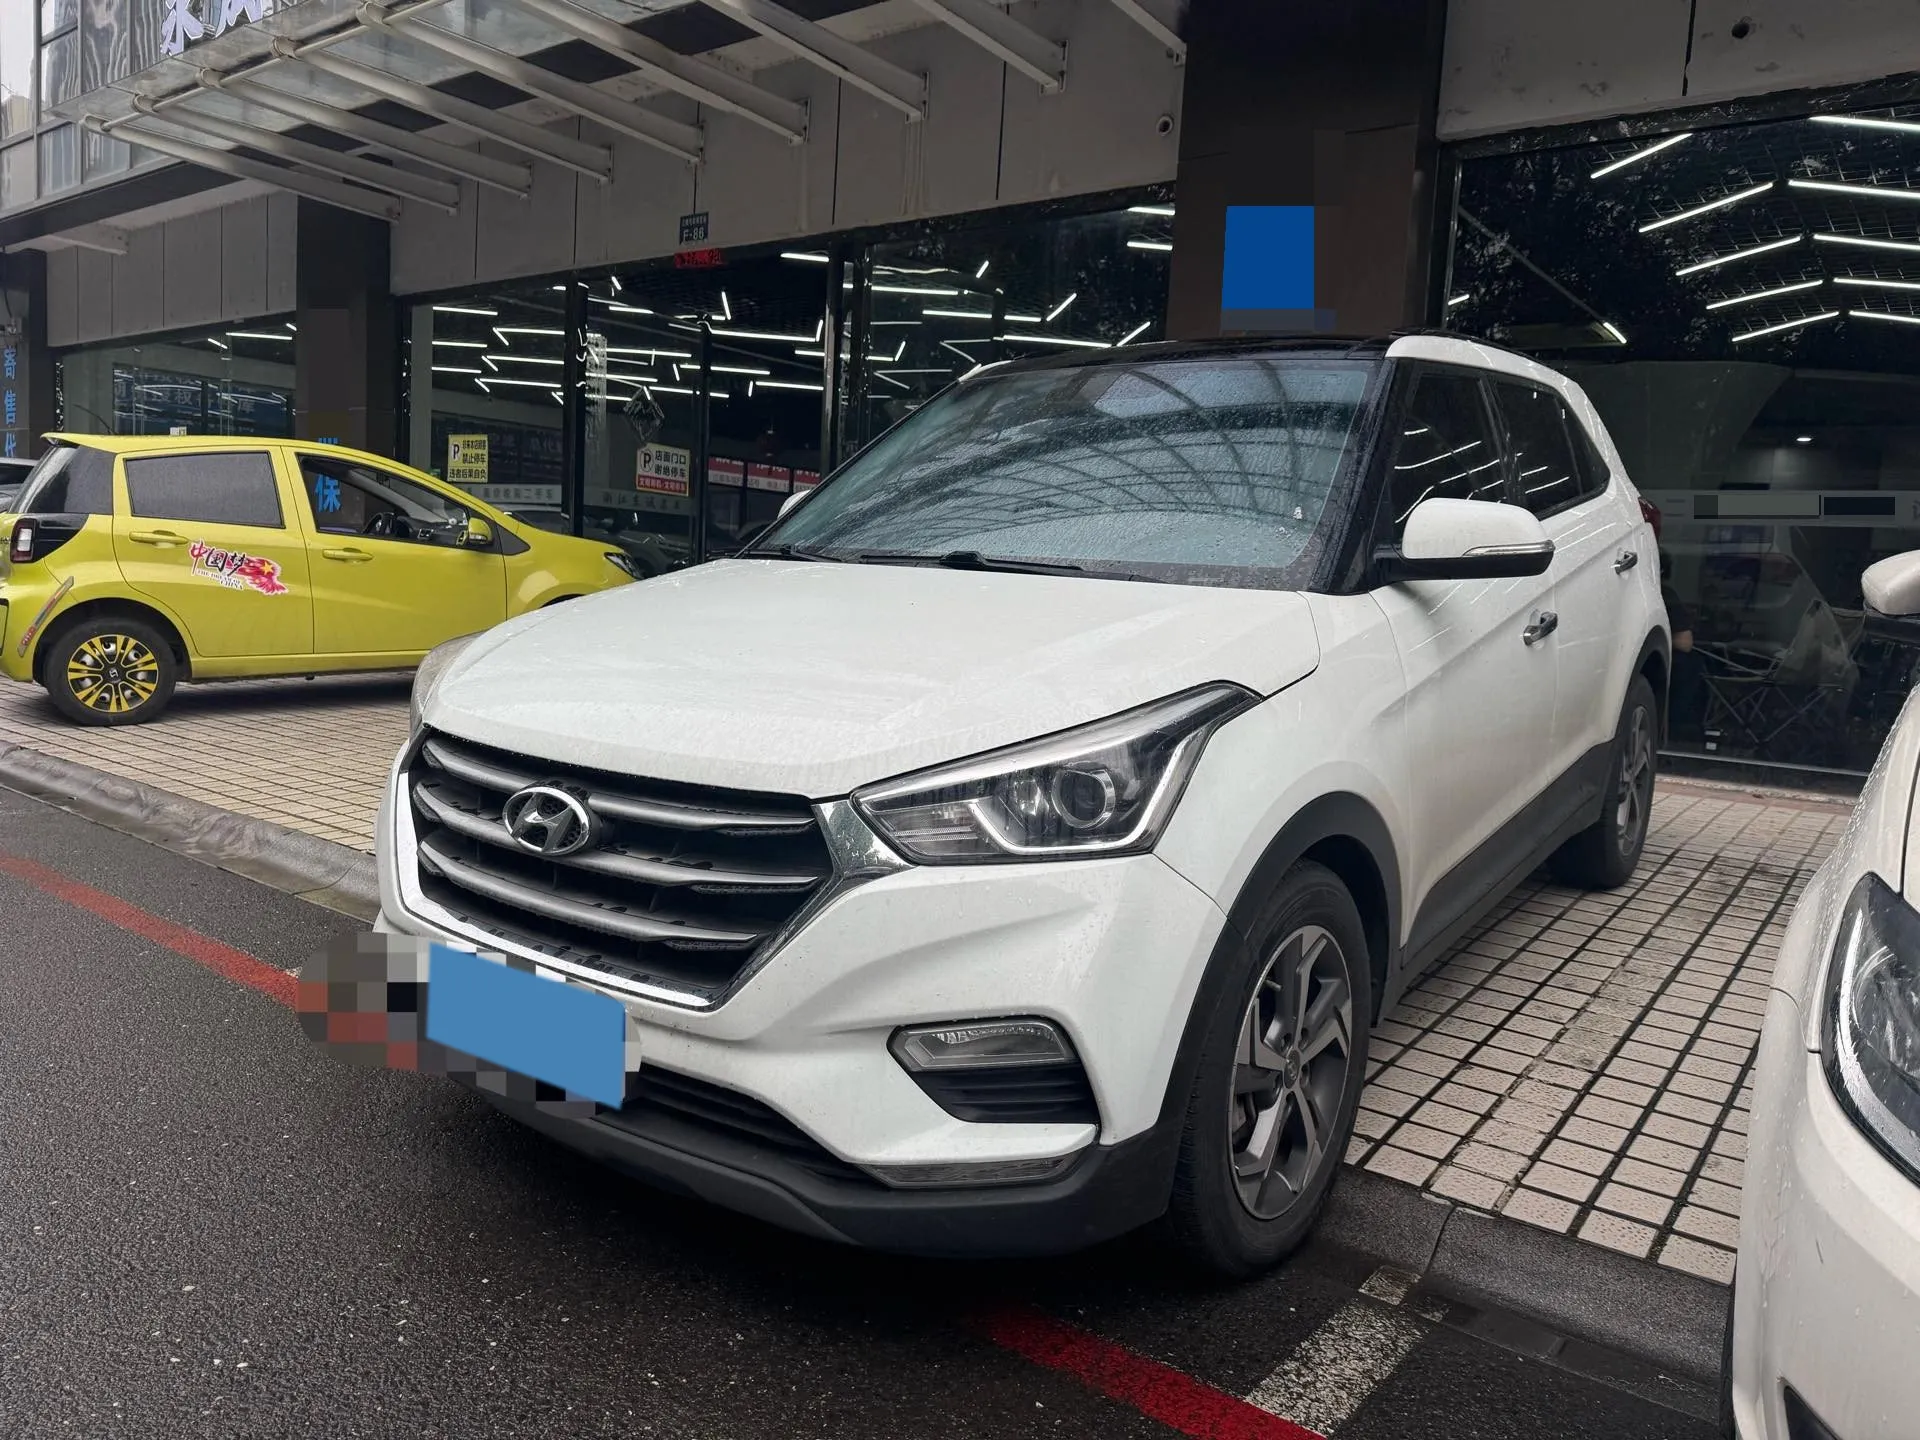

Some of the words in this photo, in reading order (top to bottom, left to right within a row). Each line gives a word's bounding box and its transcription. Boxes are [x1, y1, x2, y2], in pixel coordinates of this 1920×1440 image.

[462, 453, 487, 465] 禁止停车
[655, 450, 687, 464] 店面门口
[449, 468, 487, 479] 违者后果自负
[655, 464, 687, 478] 谢绝停车
[315, 474, 341, 513] 保
[190, 540, 246, 577] 中国梦
